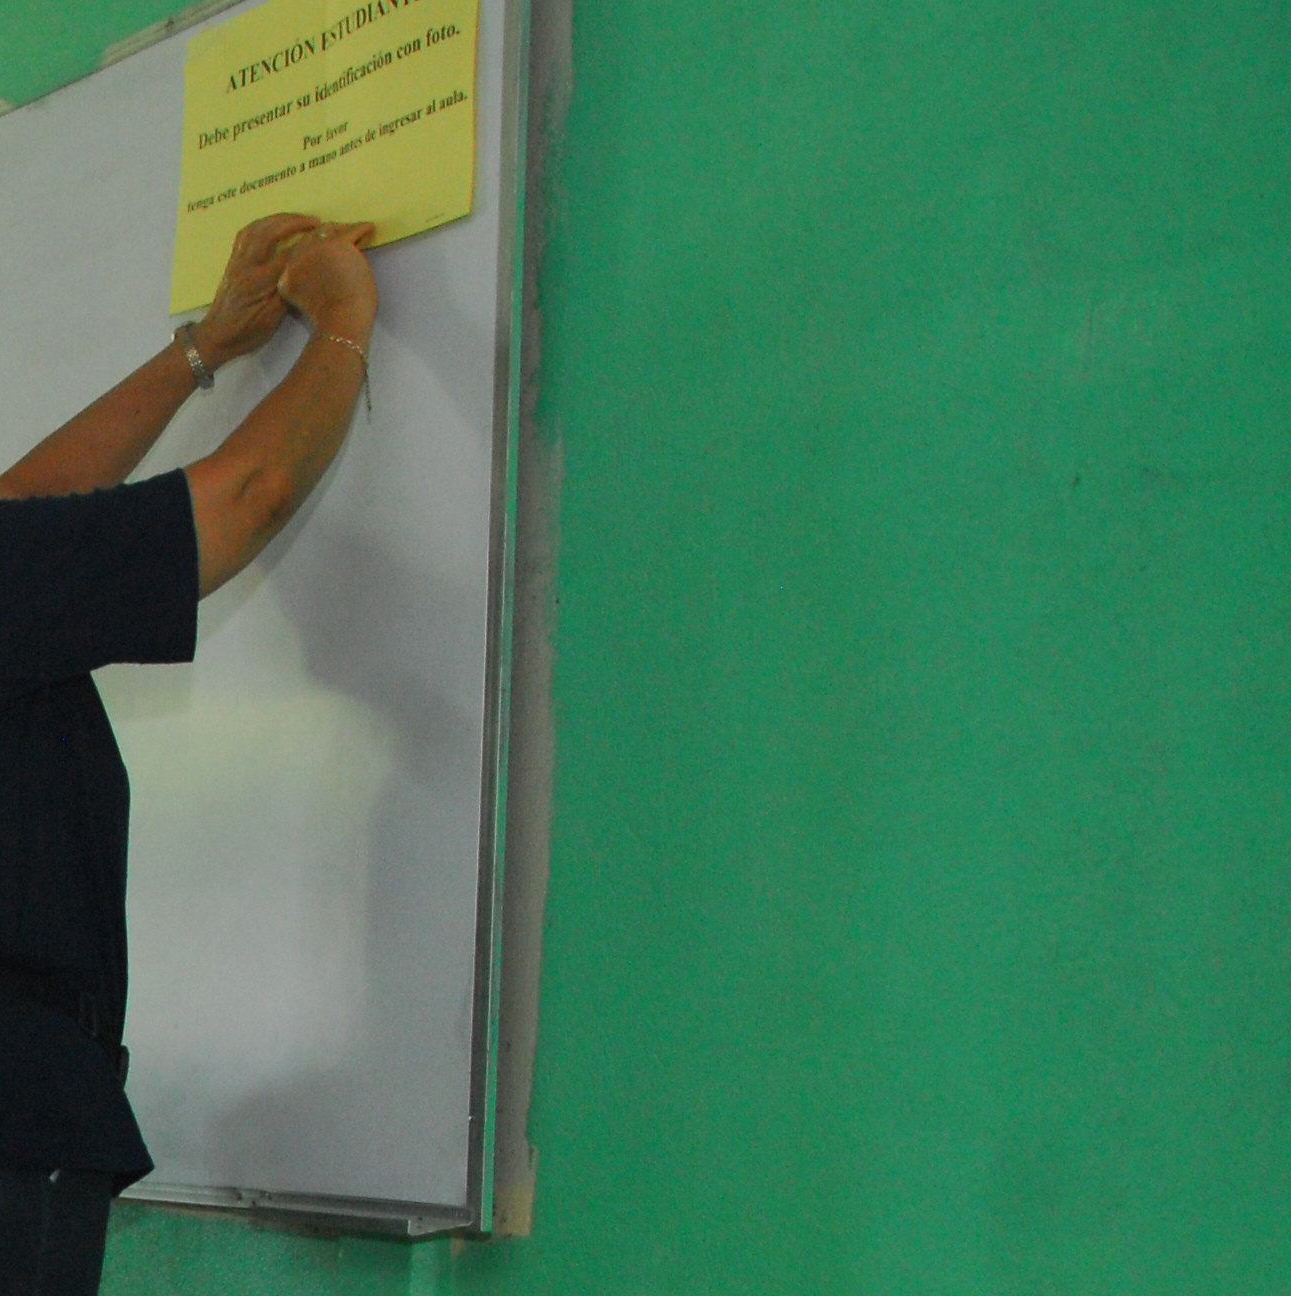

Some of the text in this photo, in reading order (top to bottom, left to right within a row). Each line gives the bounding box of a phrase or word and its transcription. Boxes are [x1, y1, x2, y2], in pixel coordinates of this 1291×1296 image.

[198, 24, 460, 149] Debe presentar su identificación con foto.
[226, 36, 315, 93] ATENCIÓN
[187, 89, 468, 213] tenga este documento a mano antes de ingresar al aula.
[303, 121, 349, 150] Por favor
